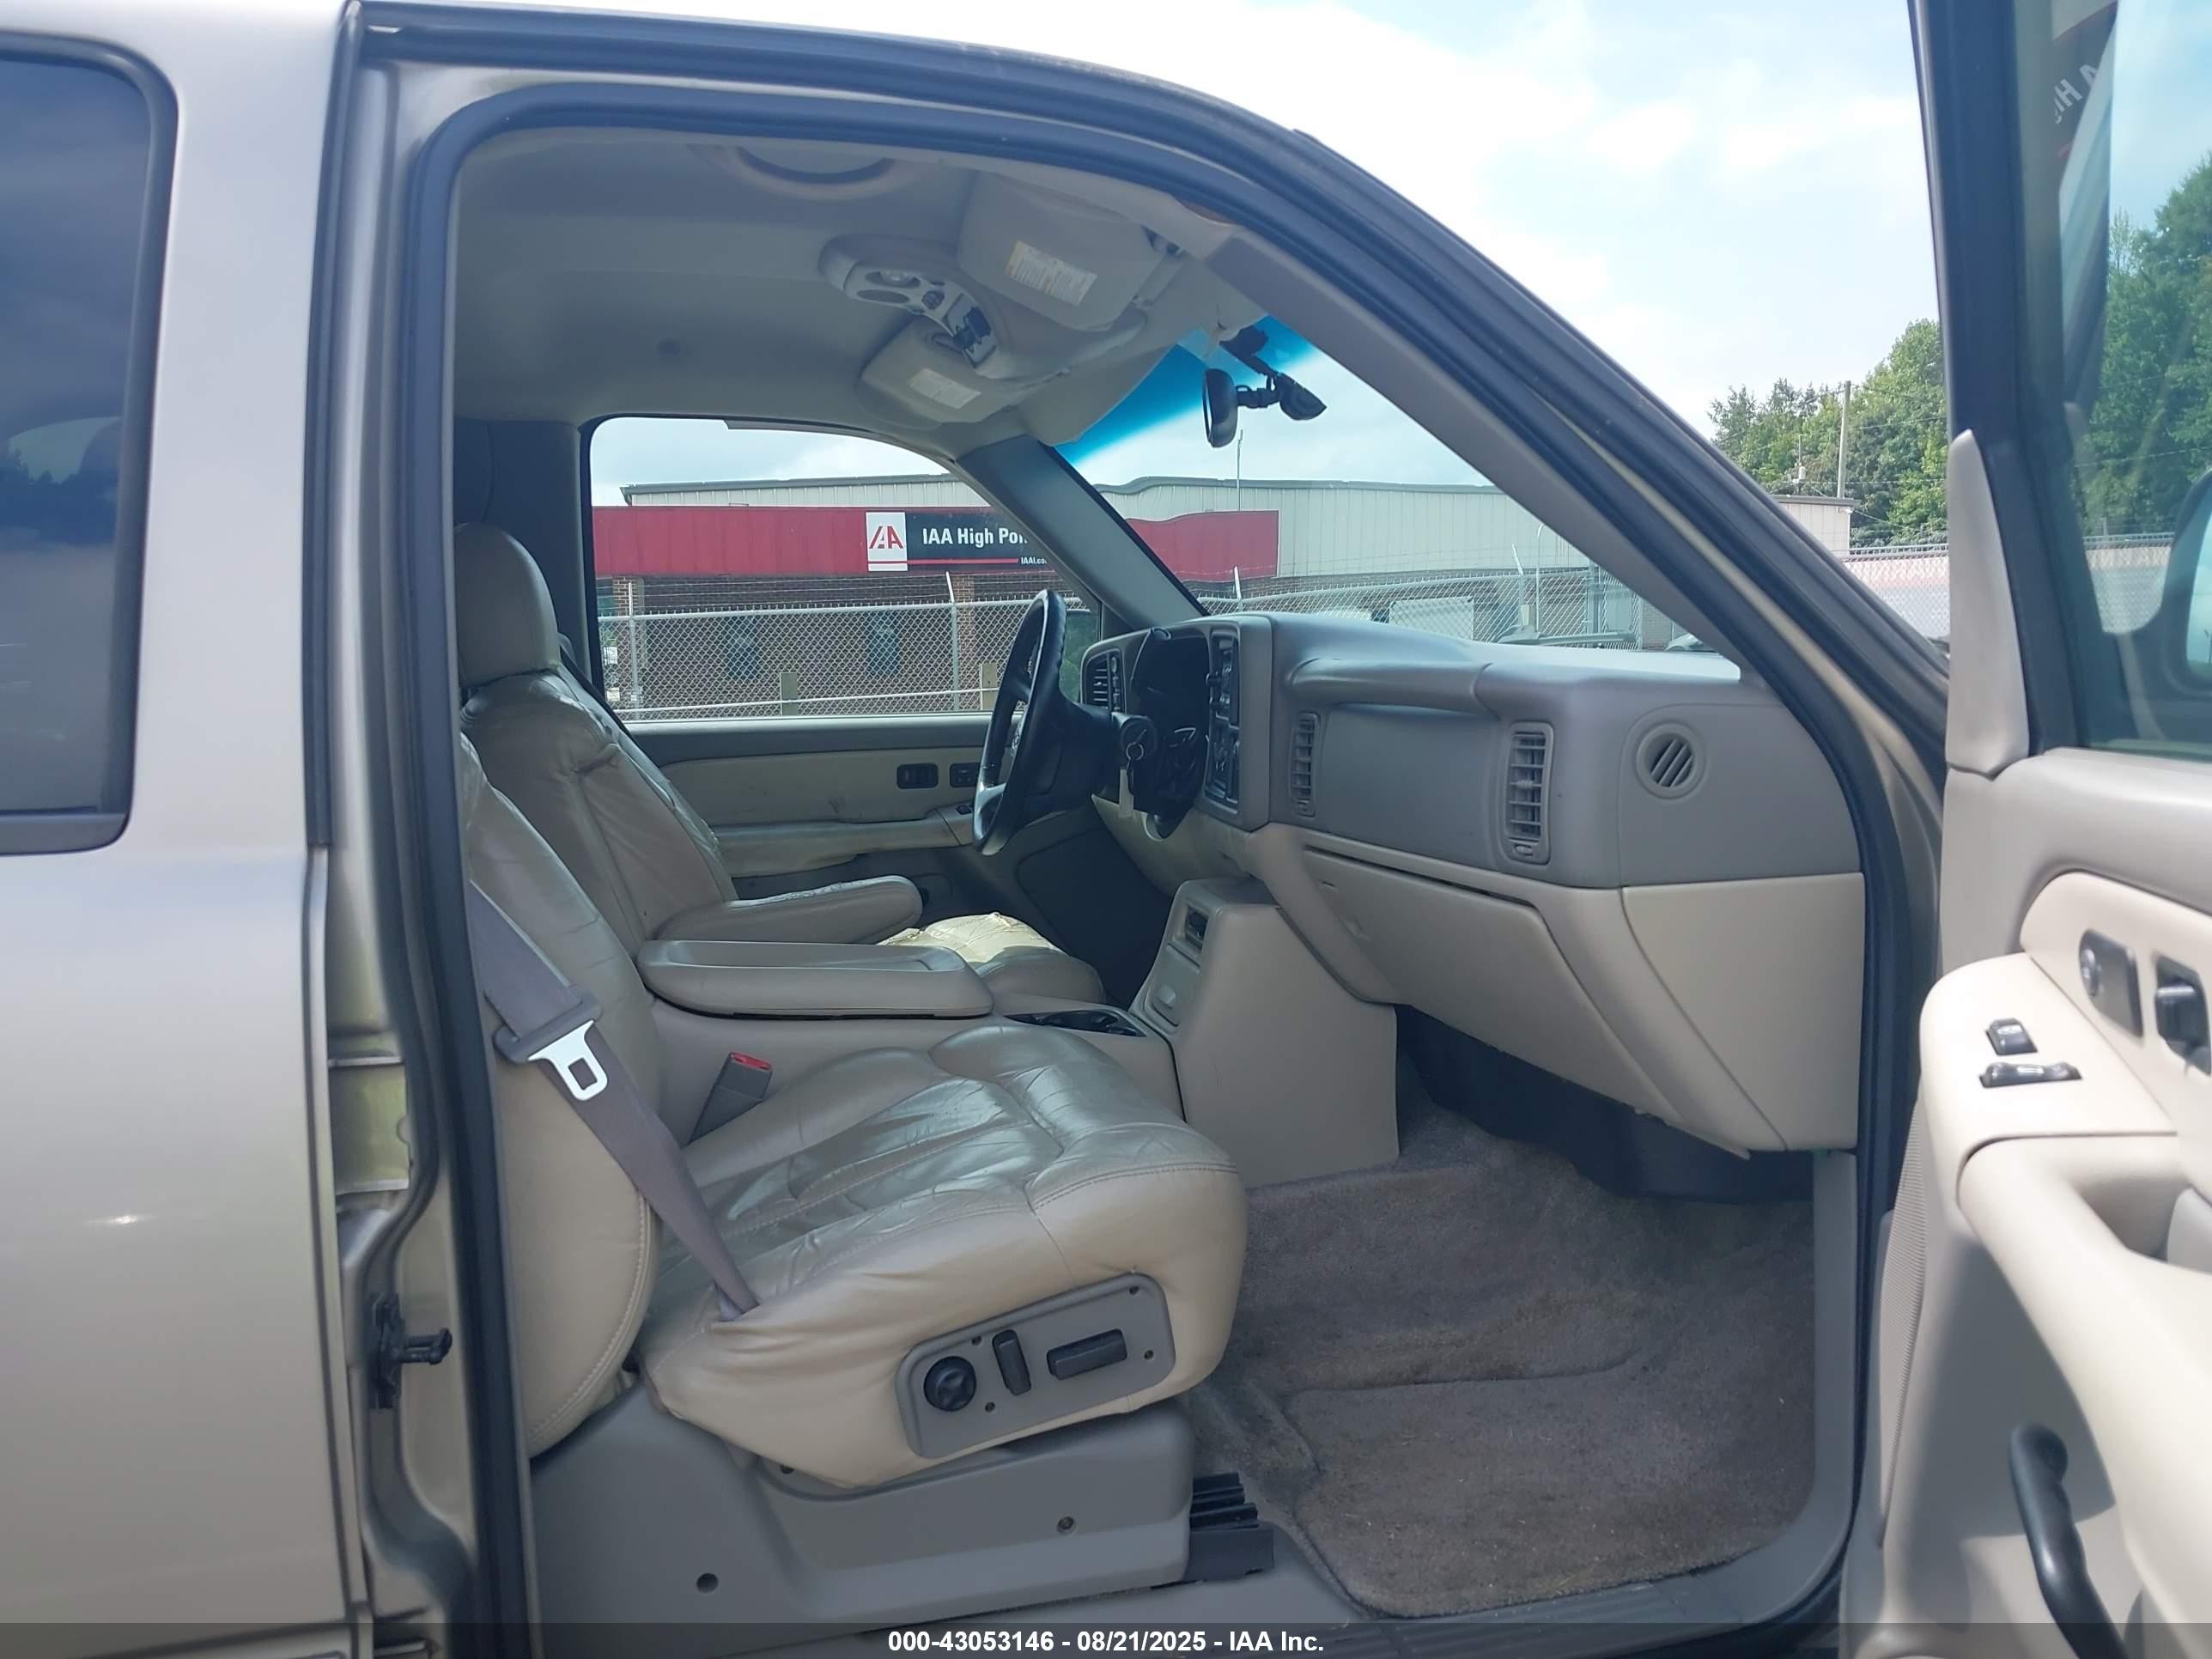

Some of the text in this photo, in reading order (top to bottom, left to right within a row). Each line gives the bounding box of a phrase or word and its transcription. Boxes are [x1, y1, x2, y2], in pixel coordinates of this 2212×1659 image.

[922, 527, 953, 544] IAA
[957, 527, 994, 548] High
[1020, 556, 1048, 565] IAAI.co
